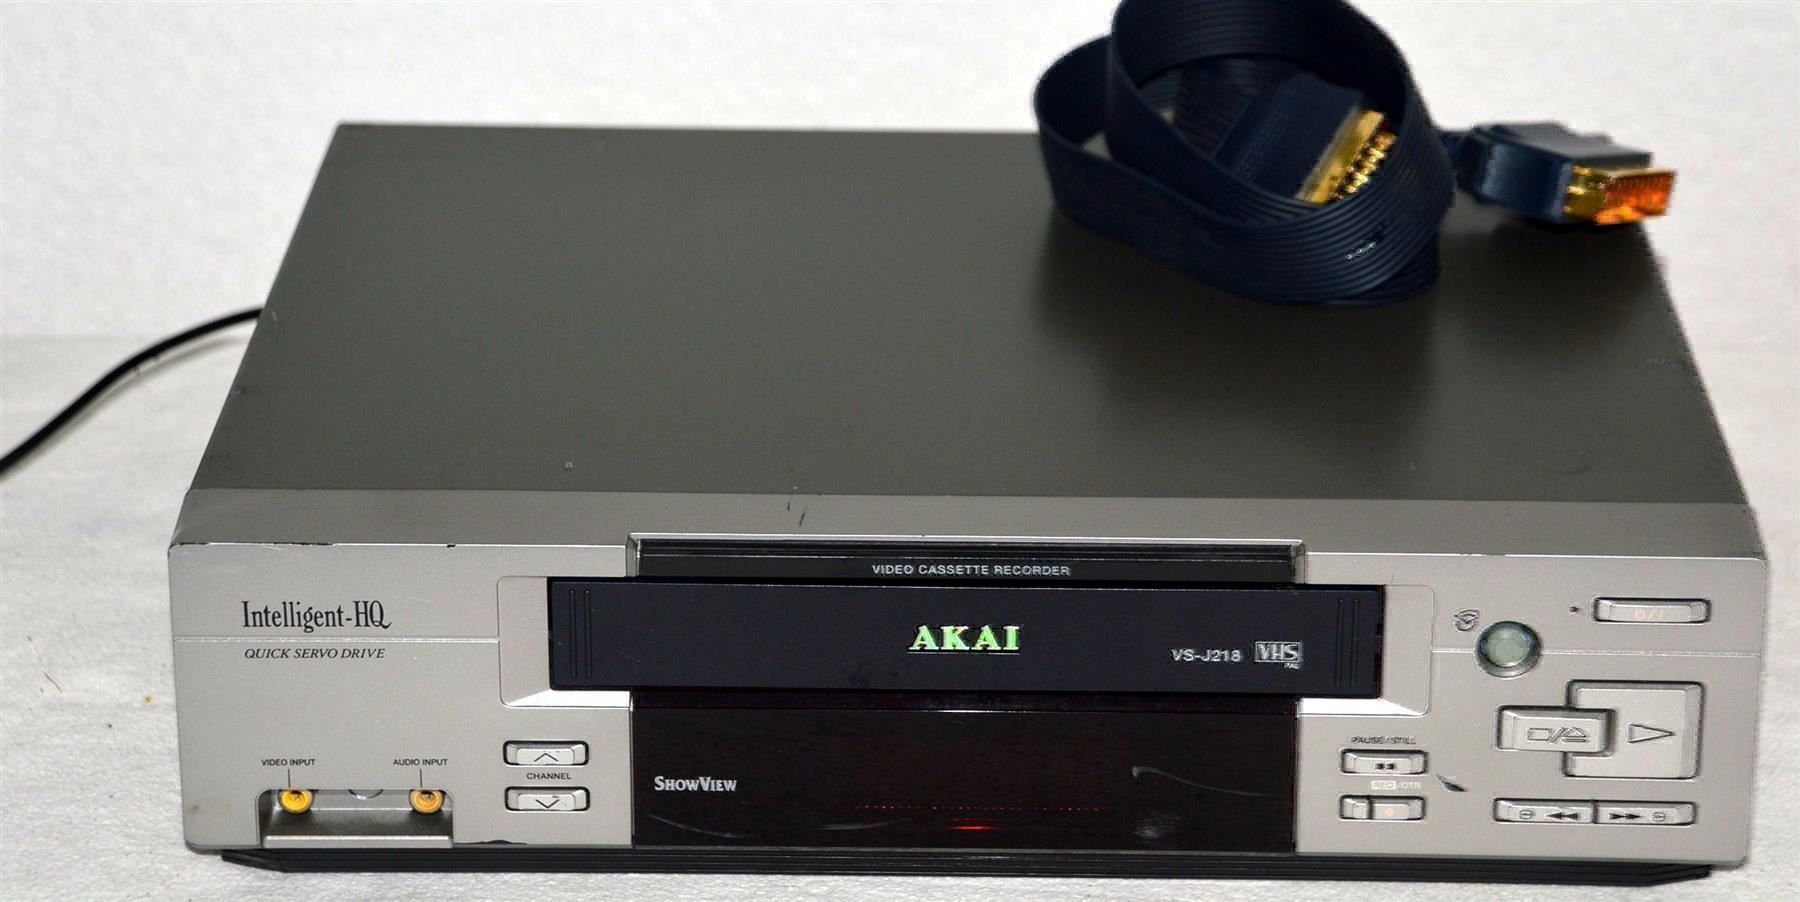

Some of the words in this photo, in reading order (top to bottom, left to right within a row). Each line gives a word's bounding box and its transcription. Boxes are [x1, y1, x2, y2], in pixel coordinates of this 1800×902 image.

[872, 564, 914, 575] VIDEO
[918, 564, 989, 576] CASSETTE
[993, 565, 1071, 577] RECORDER
[241, 600, 392, 633] Intelligent-HQ
[908, 624, 1021, 651] AKAI
[244, 648, 292, 660] QUICK
[293, 648, 339, 659] SERVO
[340, 648, 386, 659] DRIVE
[1171, 648, 1242, 662] VS-J218
[1256, 641, 1300, 662] VHS
[261, 758, 287, 767] VIDEO
[288, 758, 316, 767] INPUT
[393, 758, 420, 767] AUDIO
[421, 758, 448, 767] INPUT
[526, 771, 573, 781] CHANNEL
